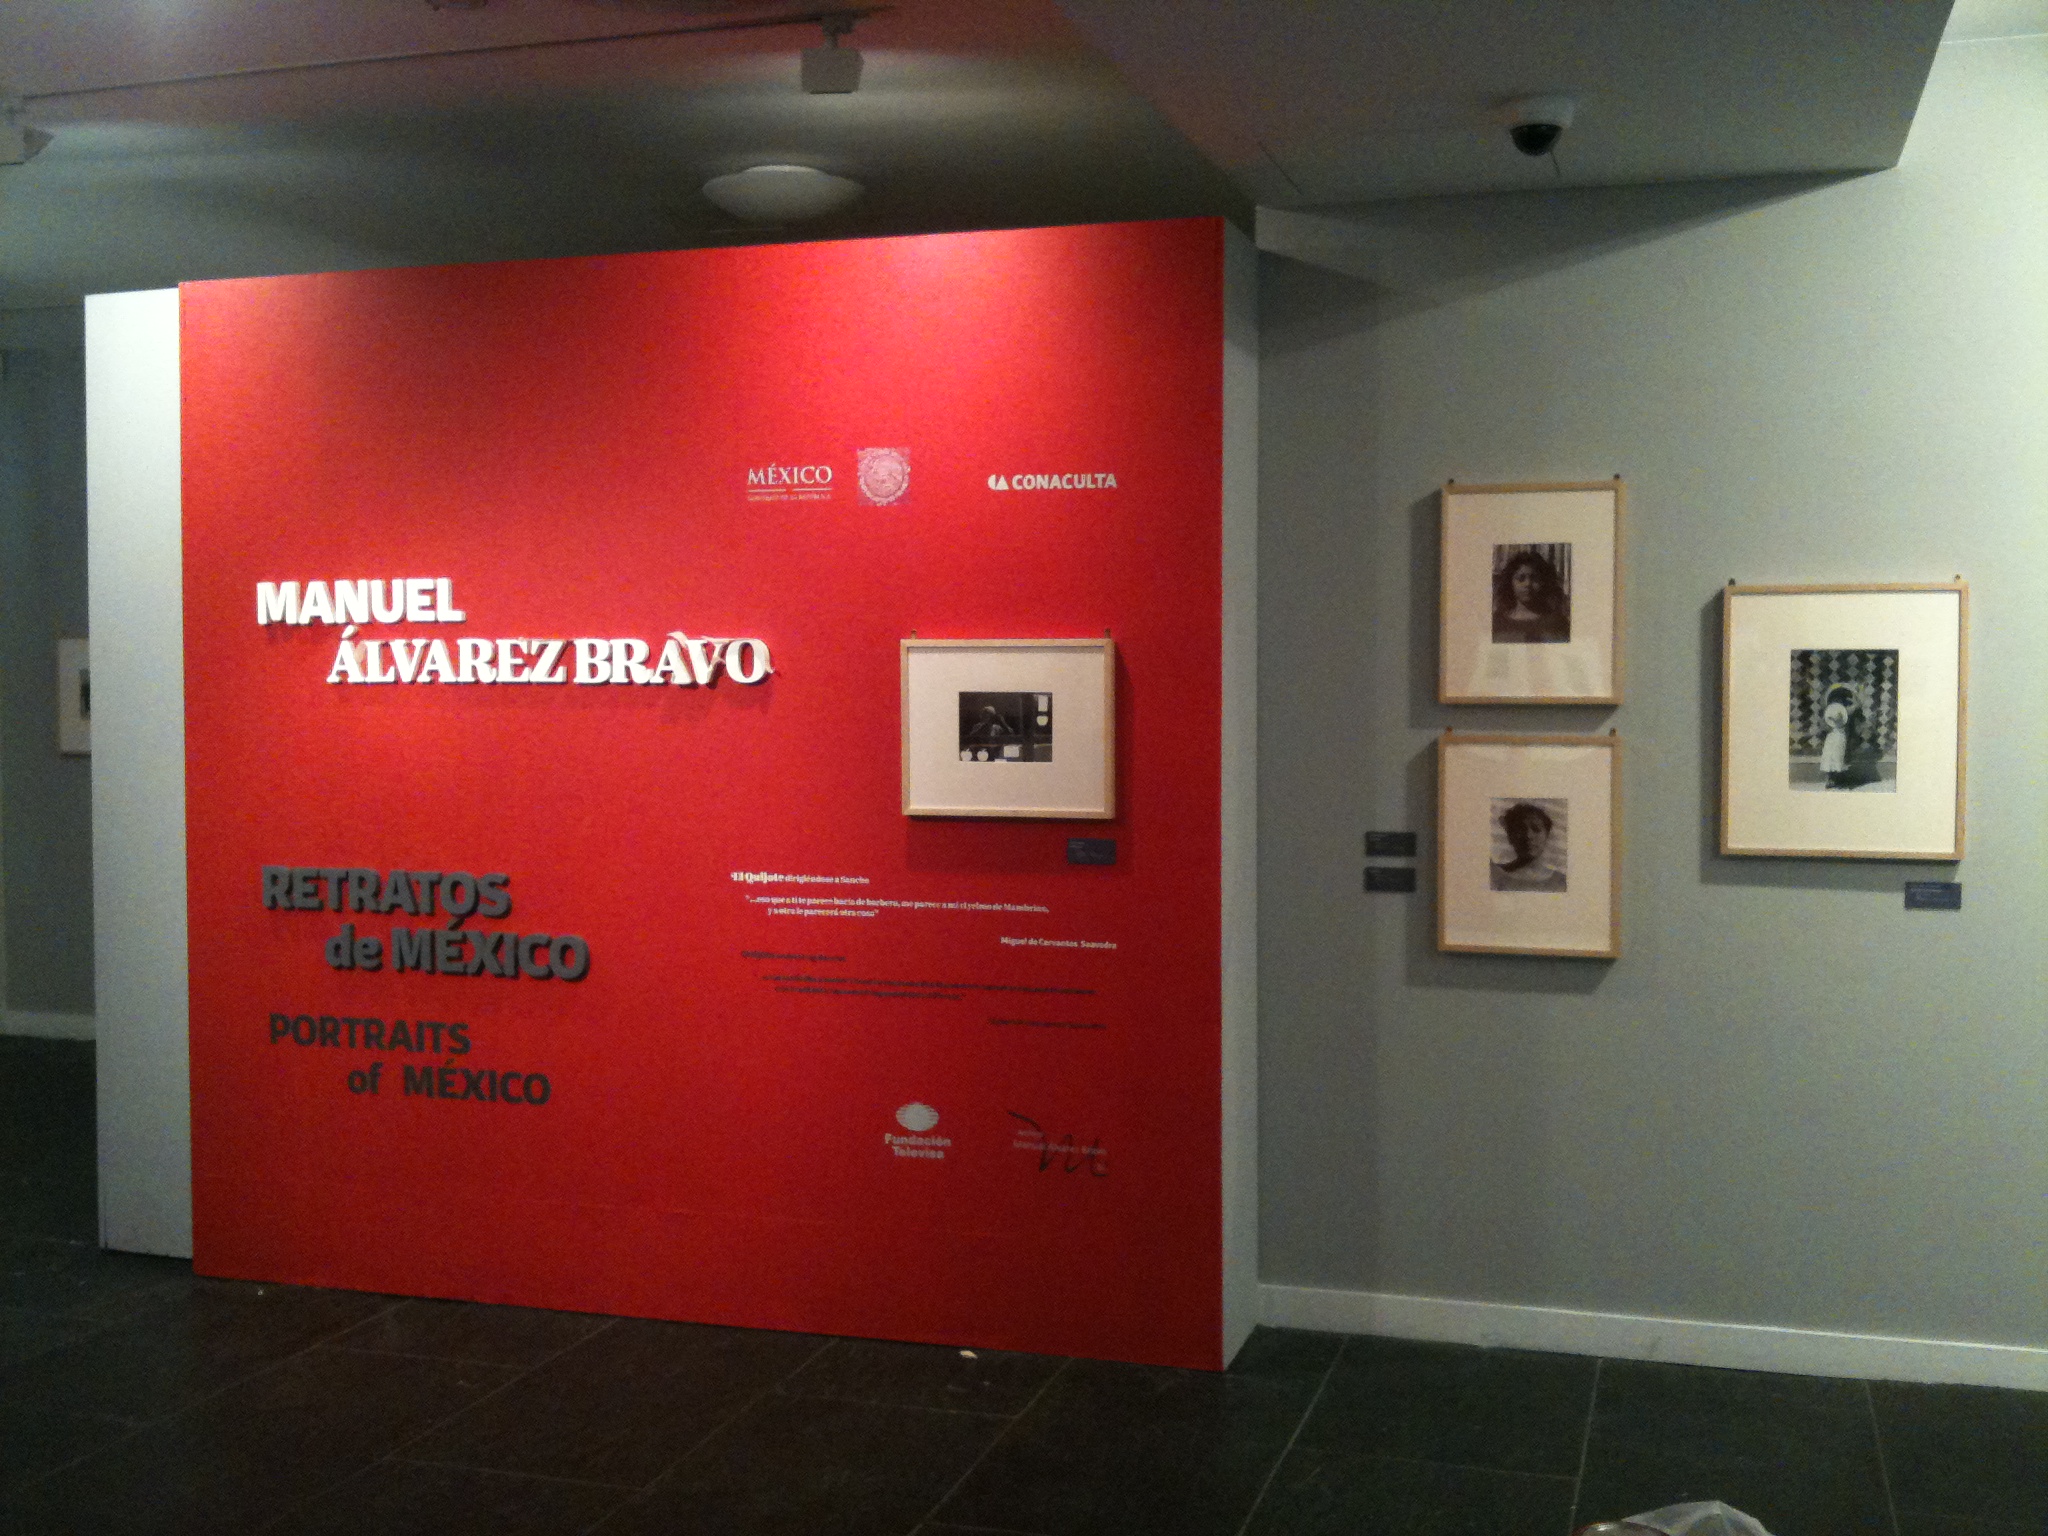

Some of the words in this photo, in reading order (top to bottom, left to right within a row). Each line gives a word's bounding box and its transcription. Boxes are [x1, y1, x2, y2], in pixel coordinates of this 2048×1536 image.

[747, 463, 832, 485] MÉXICO
[1011, 473, 1118, 490] CONACULTA
[256, 578, 466, 626] MANUEL
[327, 625, 568, 685] ÁLVAREZ
[573, 631, 775, 686] BRAVO
[261, 865, 512, 919] RETRATOS
[745, 871, 784, 884] Quijote
[325, 923, 383, 971] de
[391, 918, 591, 982] MÉXICO
[1000, 936, 1027, 946] Miguel
[1027, 937, 1038, 945] de
[269, 1012, 471, 1054] PORTRAITS
[347, 1061, 383, 1094] of
[403, 1057, 552, 1105] MÉXICO
[884, 1132, 953, 1147] Fundación
